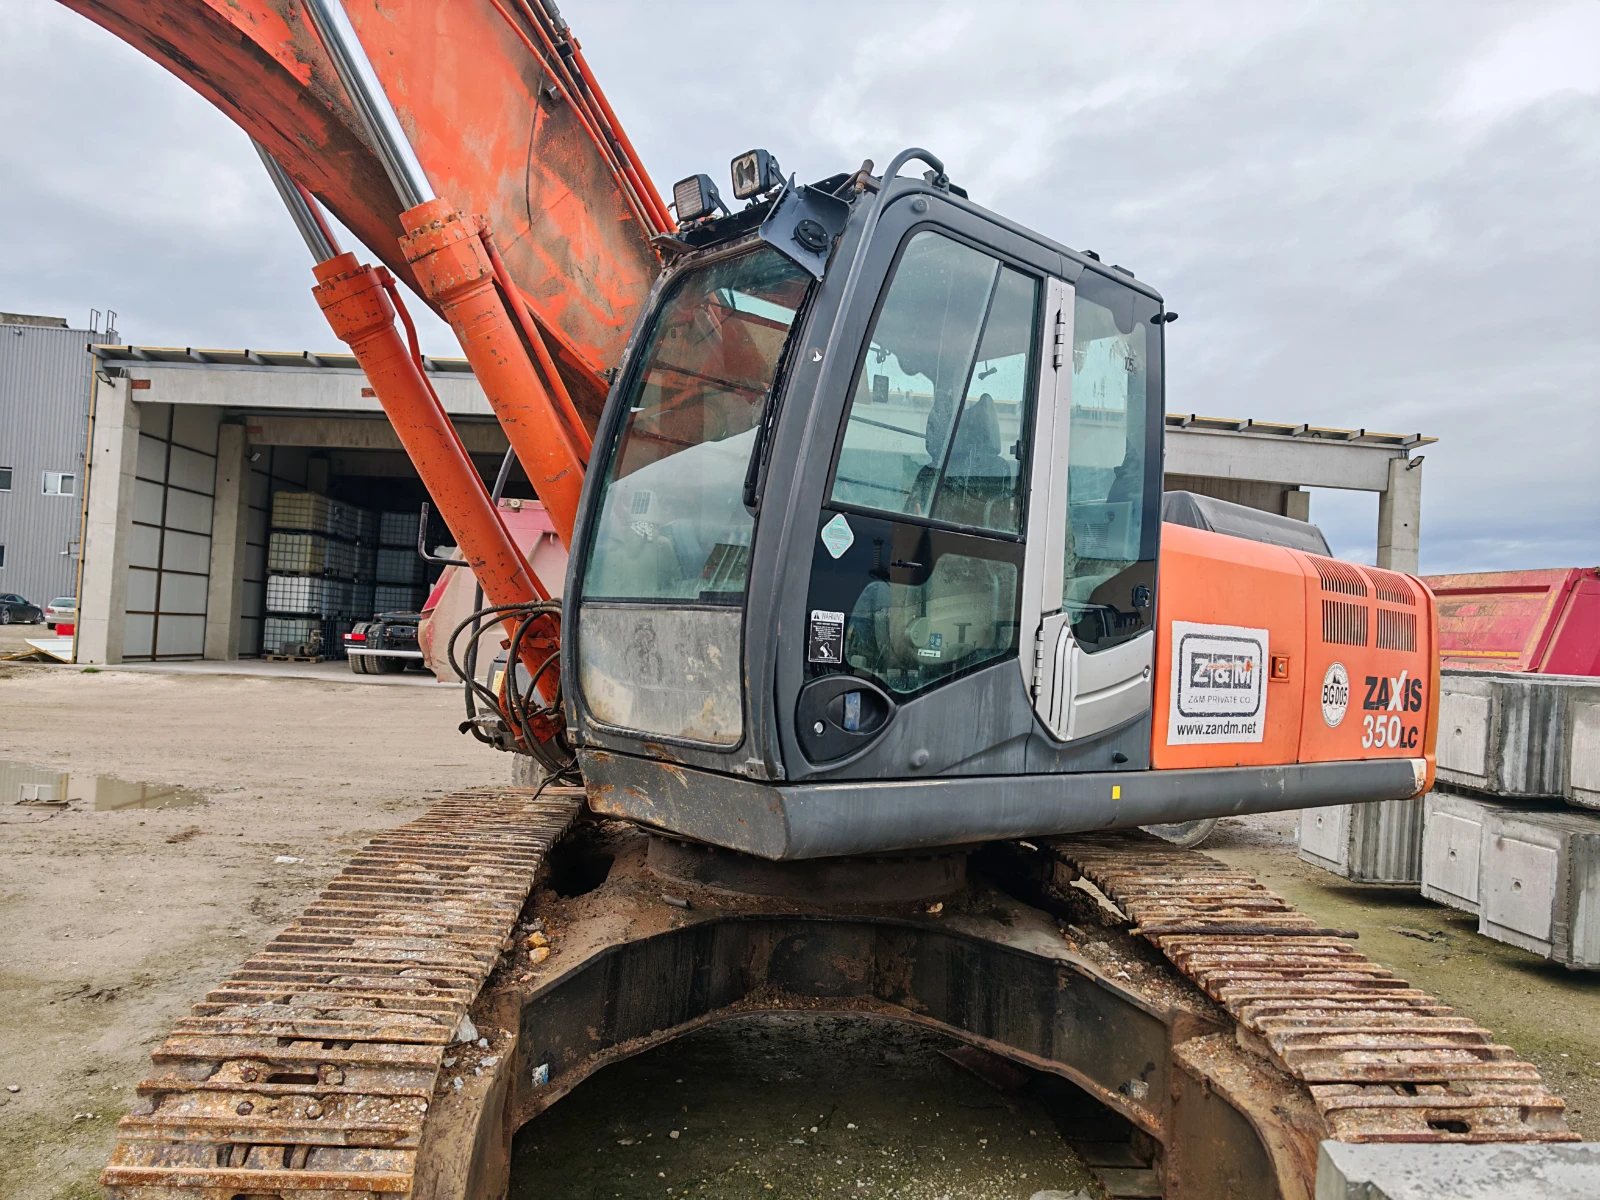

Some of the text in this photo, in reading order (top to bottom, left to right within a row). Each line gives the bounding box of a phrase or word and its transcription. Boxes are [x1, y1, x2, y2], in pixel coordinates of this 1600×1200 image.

[1193, 658, 1252, 684] Z&M
[1188, 695, 1206, 704] Z&M
[1207, 695, 1238, 704] PRIVATE
[1363, 670, 1422, 712] ZAXIS
[1177, 721, 1257, 735] www.zandm.net
